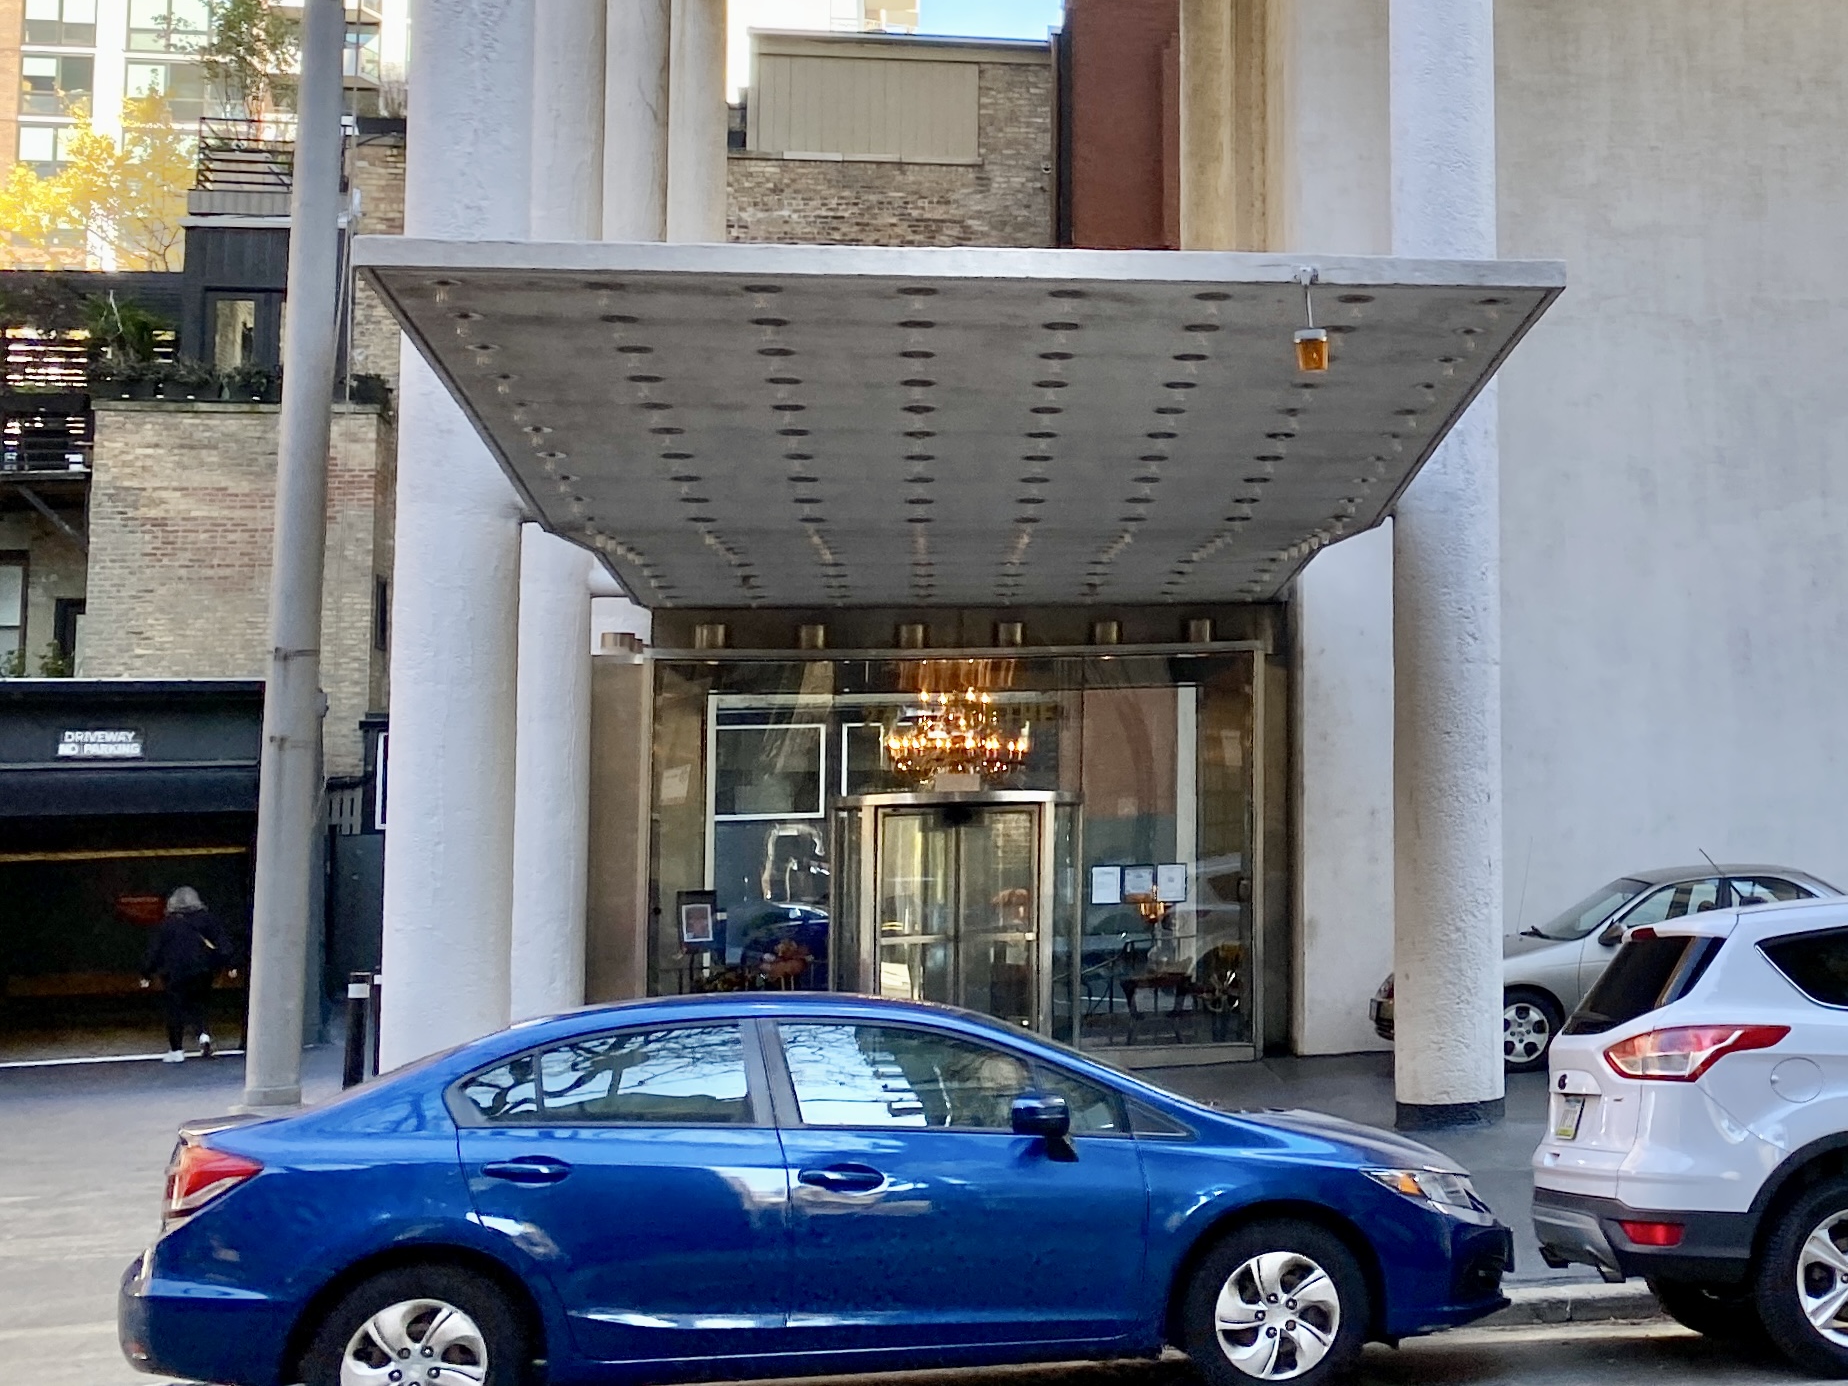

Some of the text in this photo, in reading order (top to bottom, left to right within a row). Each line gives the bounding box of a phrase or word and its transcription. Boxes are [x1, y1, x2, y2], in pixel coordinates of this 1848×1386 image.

[64, 731, 136, 742] DRIVEWAY
[57, 743, 141, 755] NO PARKING
